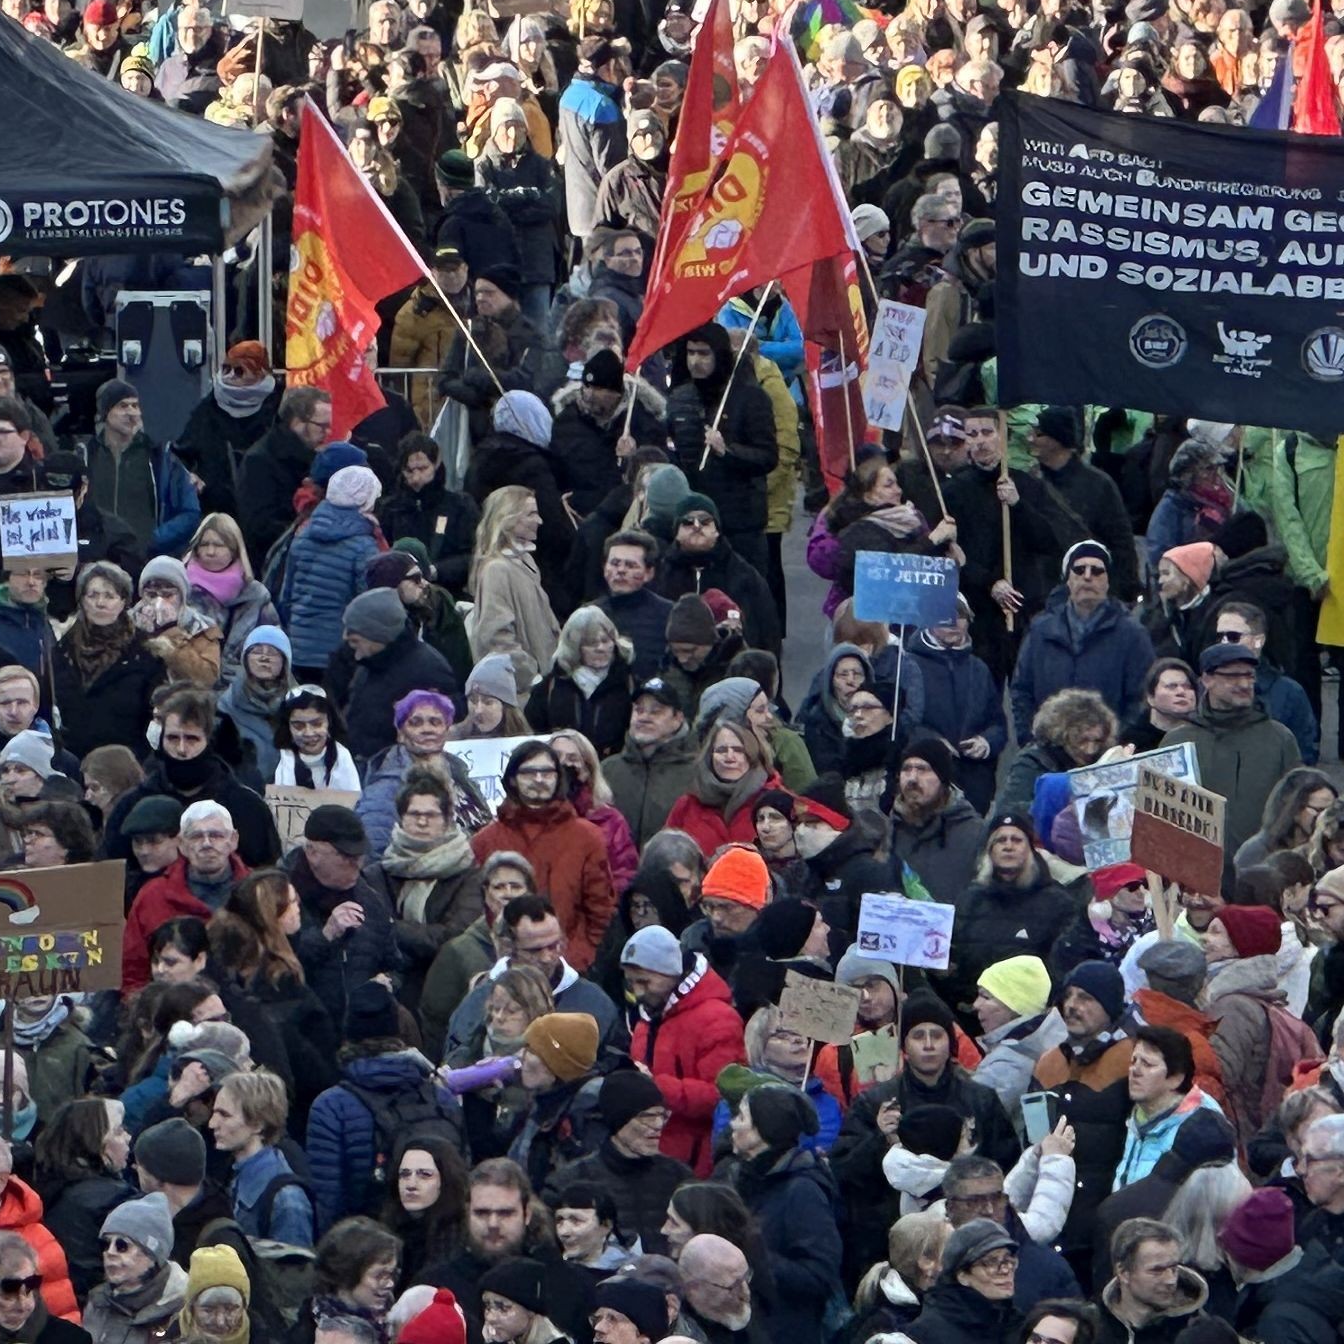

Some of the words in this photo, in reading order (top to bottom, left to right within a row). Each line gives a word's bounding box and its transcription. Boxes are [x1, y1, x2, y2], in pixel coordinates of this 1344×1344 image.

[23, 198, 186, 227] PROTONES
[1021, 181, 1275, 232] GEMEINSAM
[1021, 217, 1269, 268] RASSISMUS,
[1019, 252, 1108, 280] UND
